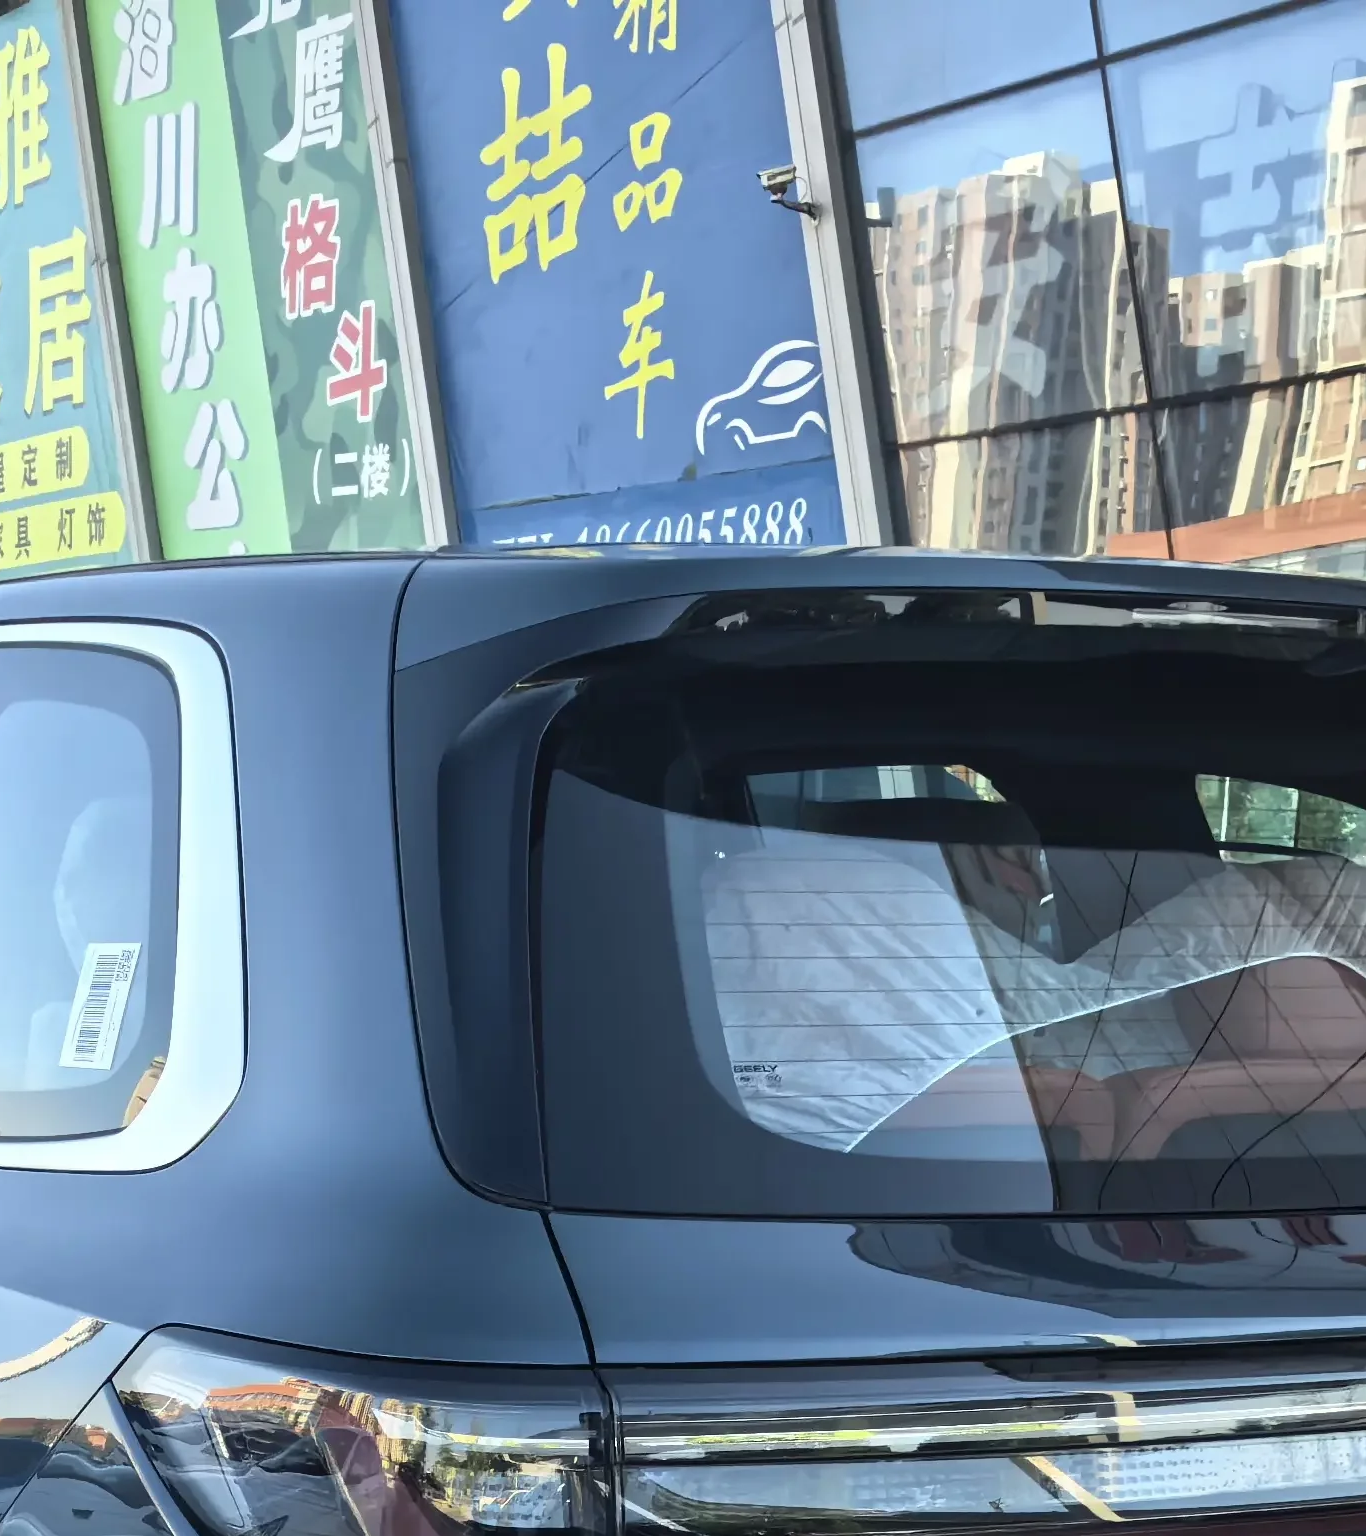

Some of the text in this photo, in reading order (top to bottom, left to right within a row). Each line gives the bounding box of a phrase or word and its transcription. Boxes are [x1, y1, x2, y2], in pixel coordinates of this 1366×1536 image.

[113, 0, 248, 556] 海川办公
[228, 0, 387, 422] 鹰格斗
[480, 0, 591, 284] 喆
[57, 502, 106, 552] 灯饰
[733, 1064, 778, 1074] GEELY
